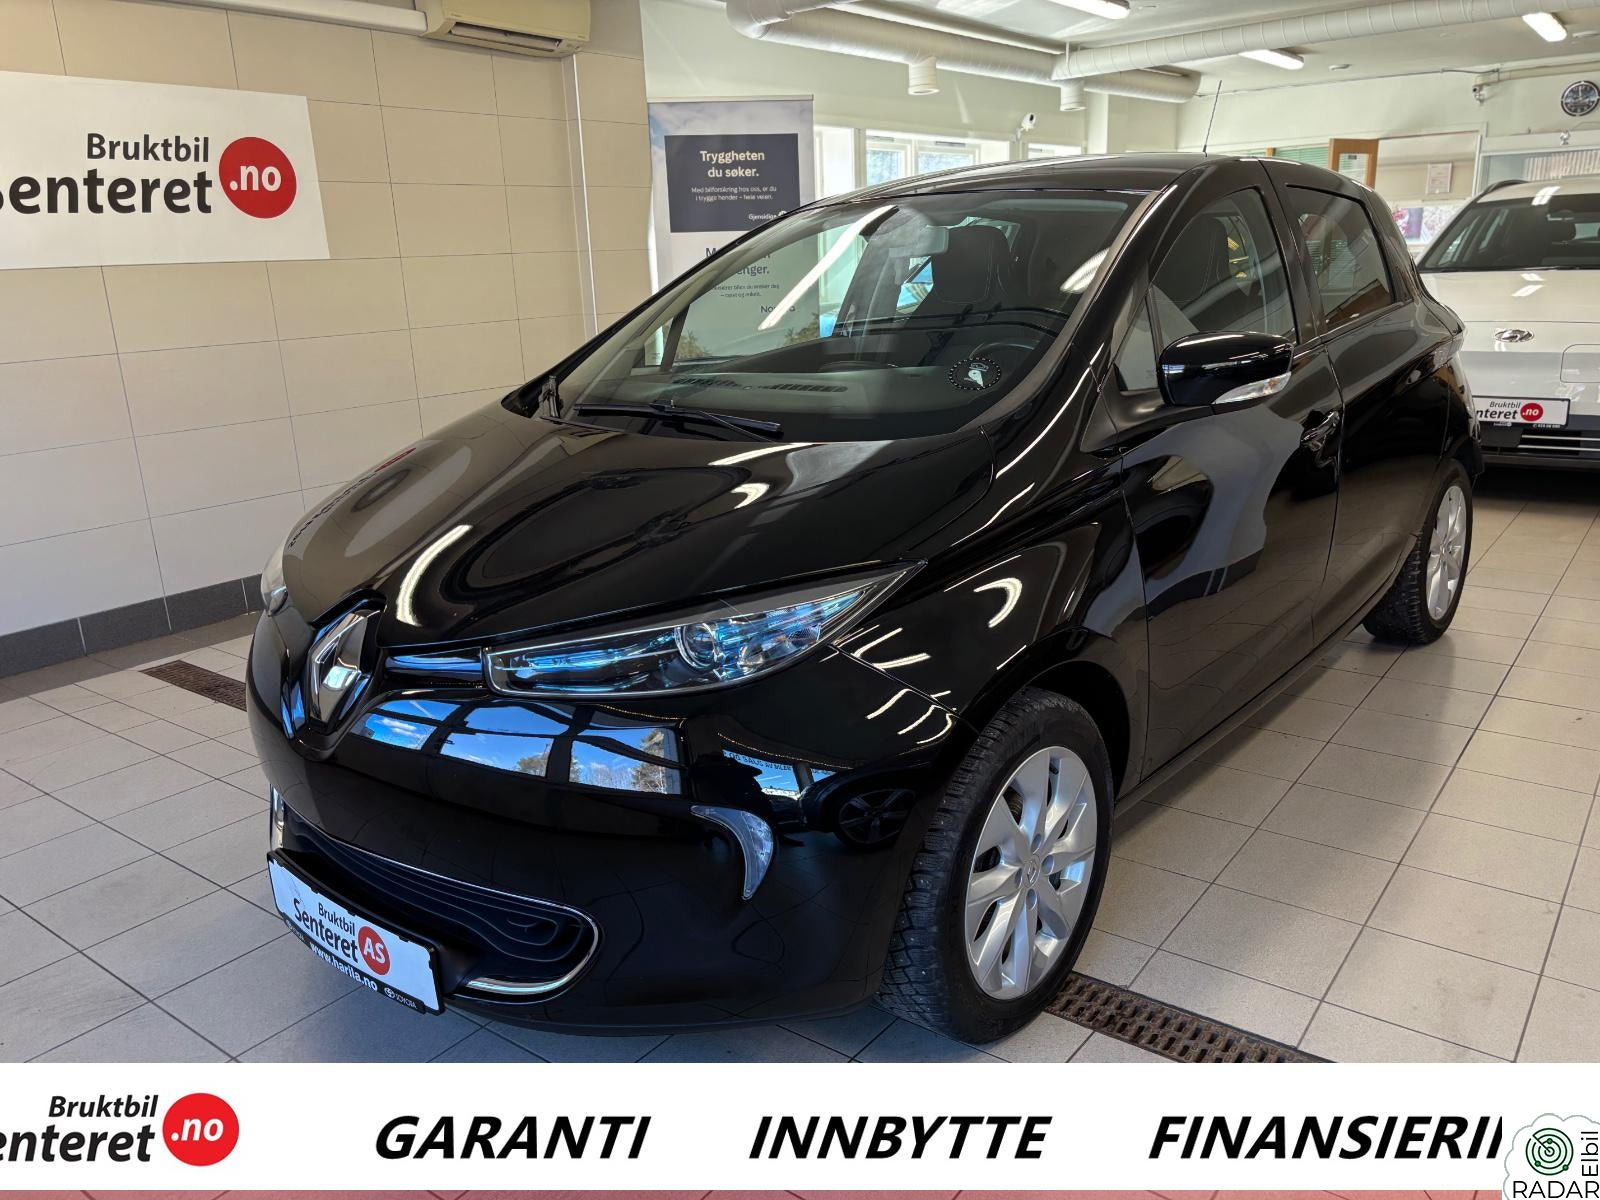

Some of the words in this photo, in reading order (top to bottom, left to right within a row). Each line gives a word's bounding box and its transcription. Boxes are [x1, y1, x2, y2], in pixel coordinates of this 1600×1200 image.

[87, 132, 209, 162] Bruktbil
[699, 150, 765, 164] Tryggheten
[707, 166, 723, 177] du
[725, 166, 760, 177] søker.
[0, 167, 213, 214] enteret
[229, 164, 282, 192] .no
[1489, 401, 1520, 409] Bruktbil
[1522, 408, 1540, 416] .no
[293, 897, 359, 964] Senteret
[363, 936, 386, 964] AS
[318, 902, 356, 937] Bruktbil
